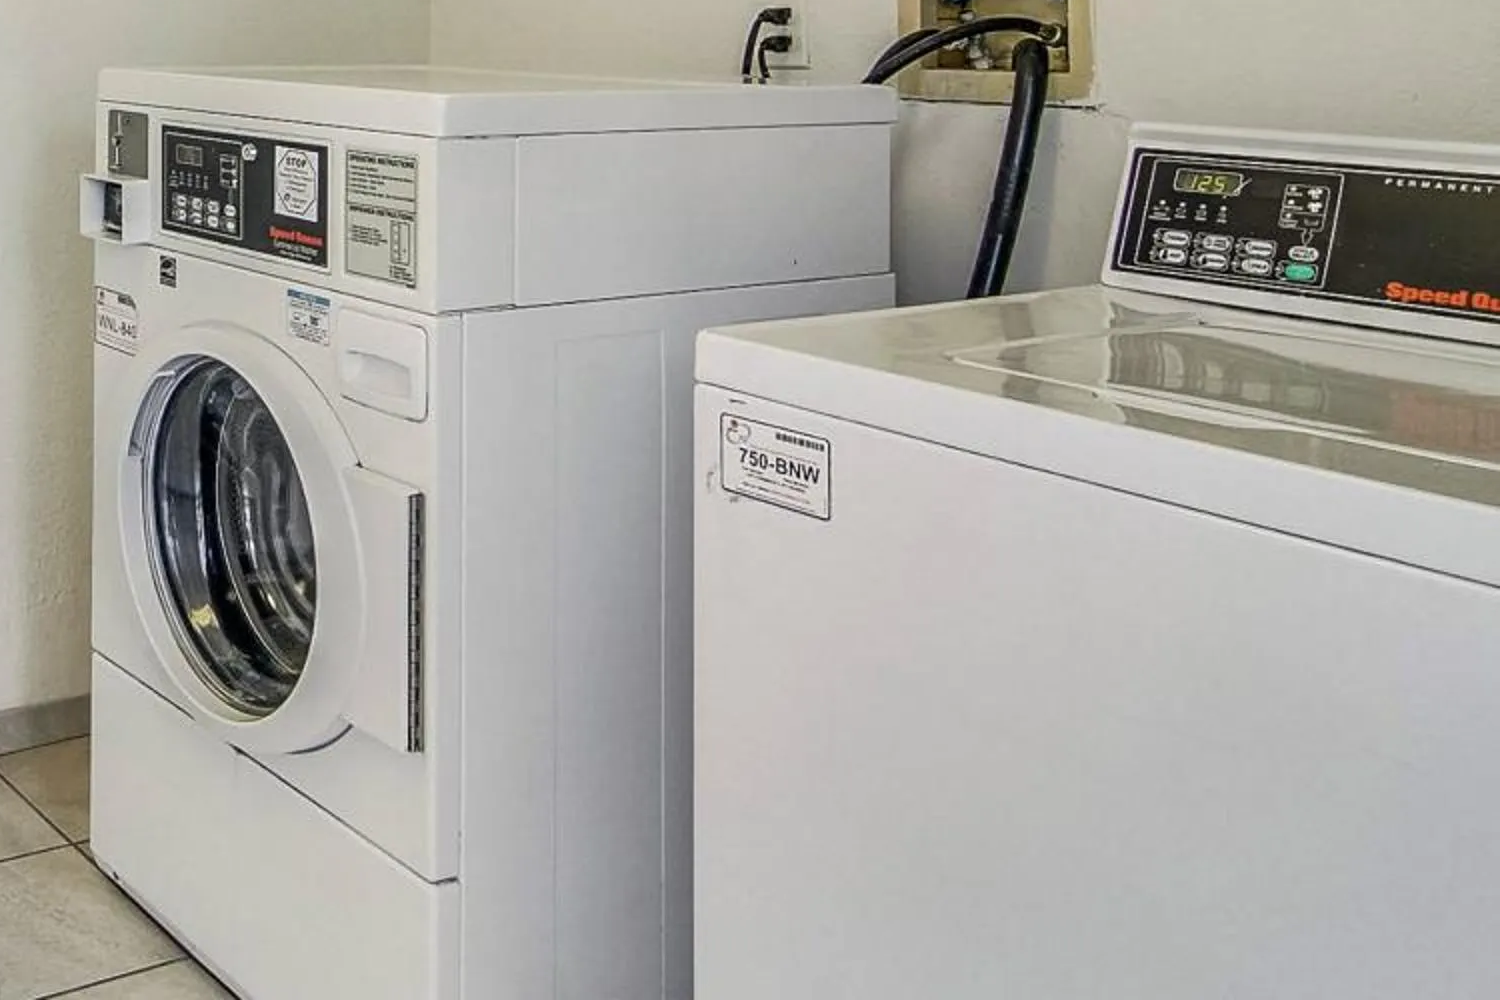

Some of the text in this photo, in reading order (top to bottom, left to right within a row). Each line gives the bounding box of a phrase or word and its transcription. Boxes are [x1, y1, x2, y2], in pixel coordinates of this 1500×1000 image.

[1384, 178, 1493, 195] PERMANENT
[1385, 281, 1469, 307] Speed
[739, 447, 821, 484] 750-BNW
